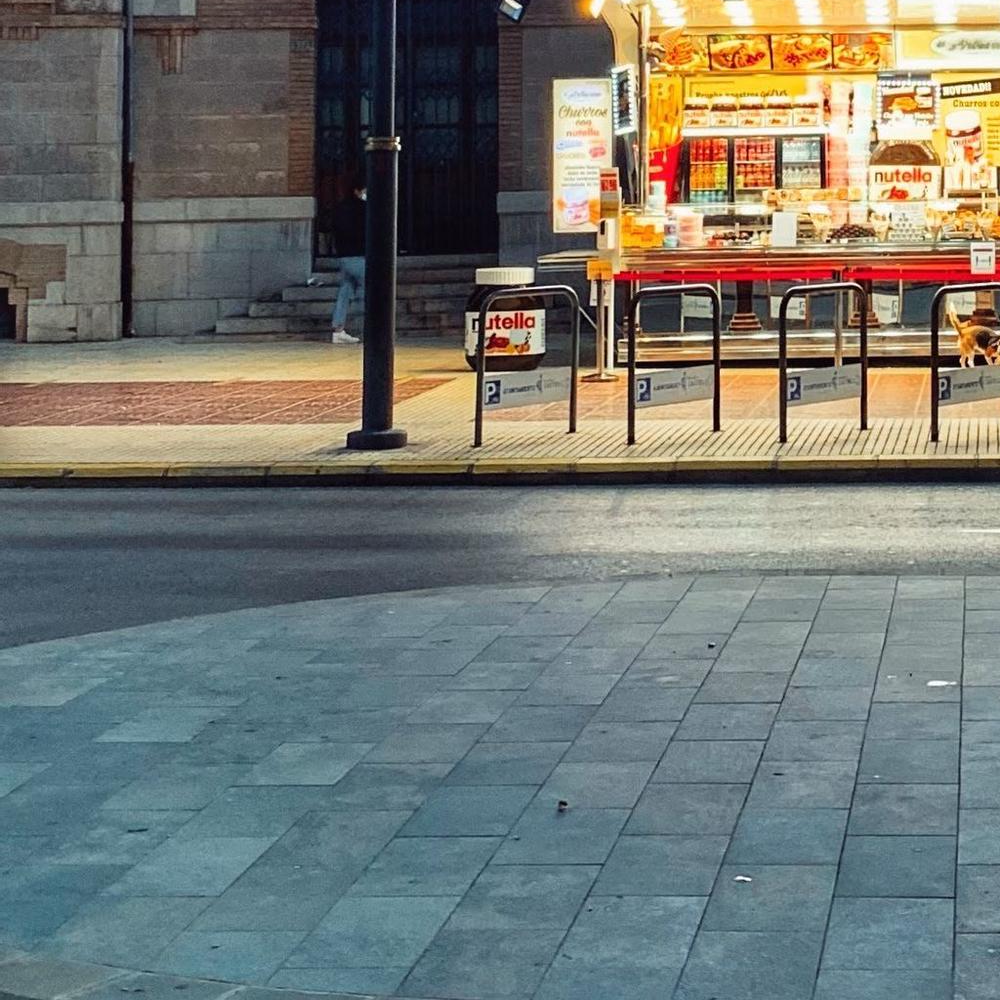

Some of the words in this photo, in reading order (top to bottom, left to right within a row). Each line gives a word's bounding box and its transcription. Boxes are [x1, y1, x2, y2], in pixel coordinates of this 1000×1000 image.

[953, 99, 987, 107] Churros
[875, 167, 932, 183] nutella
[472, 312, 536, 331] nutella
[485, 382, 497, 403] P
[637, 380, 648, 400] P
[787, 379, 797, 400] P
[939, 378, 948, 399] P
